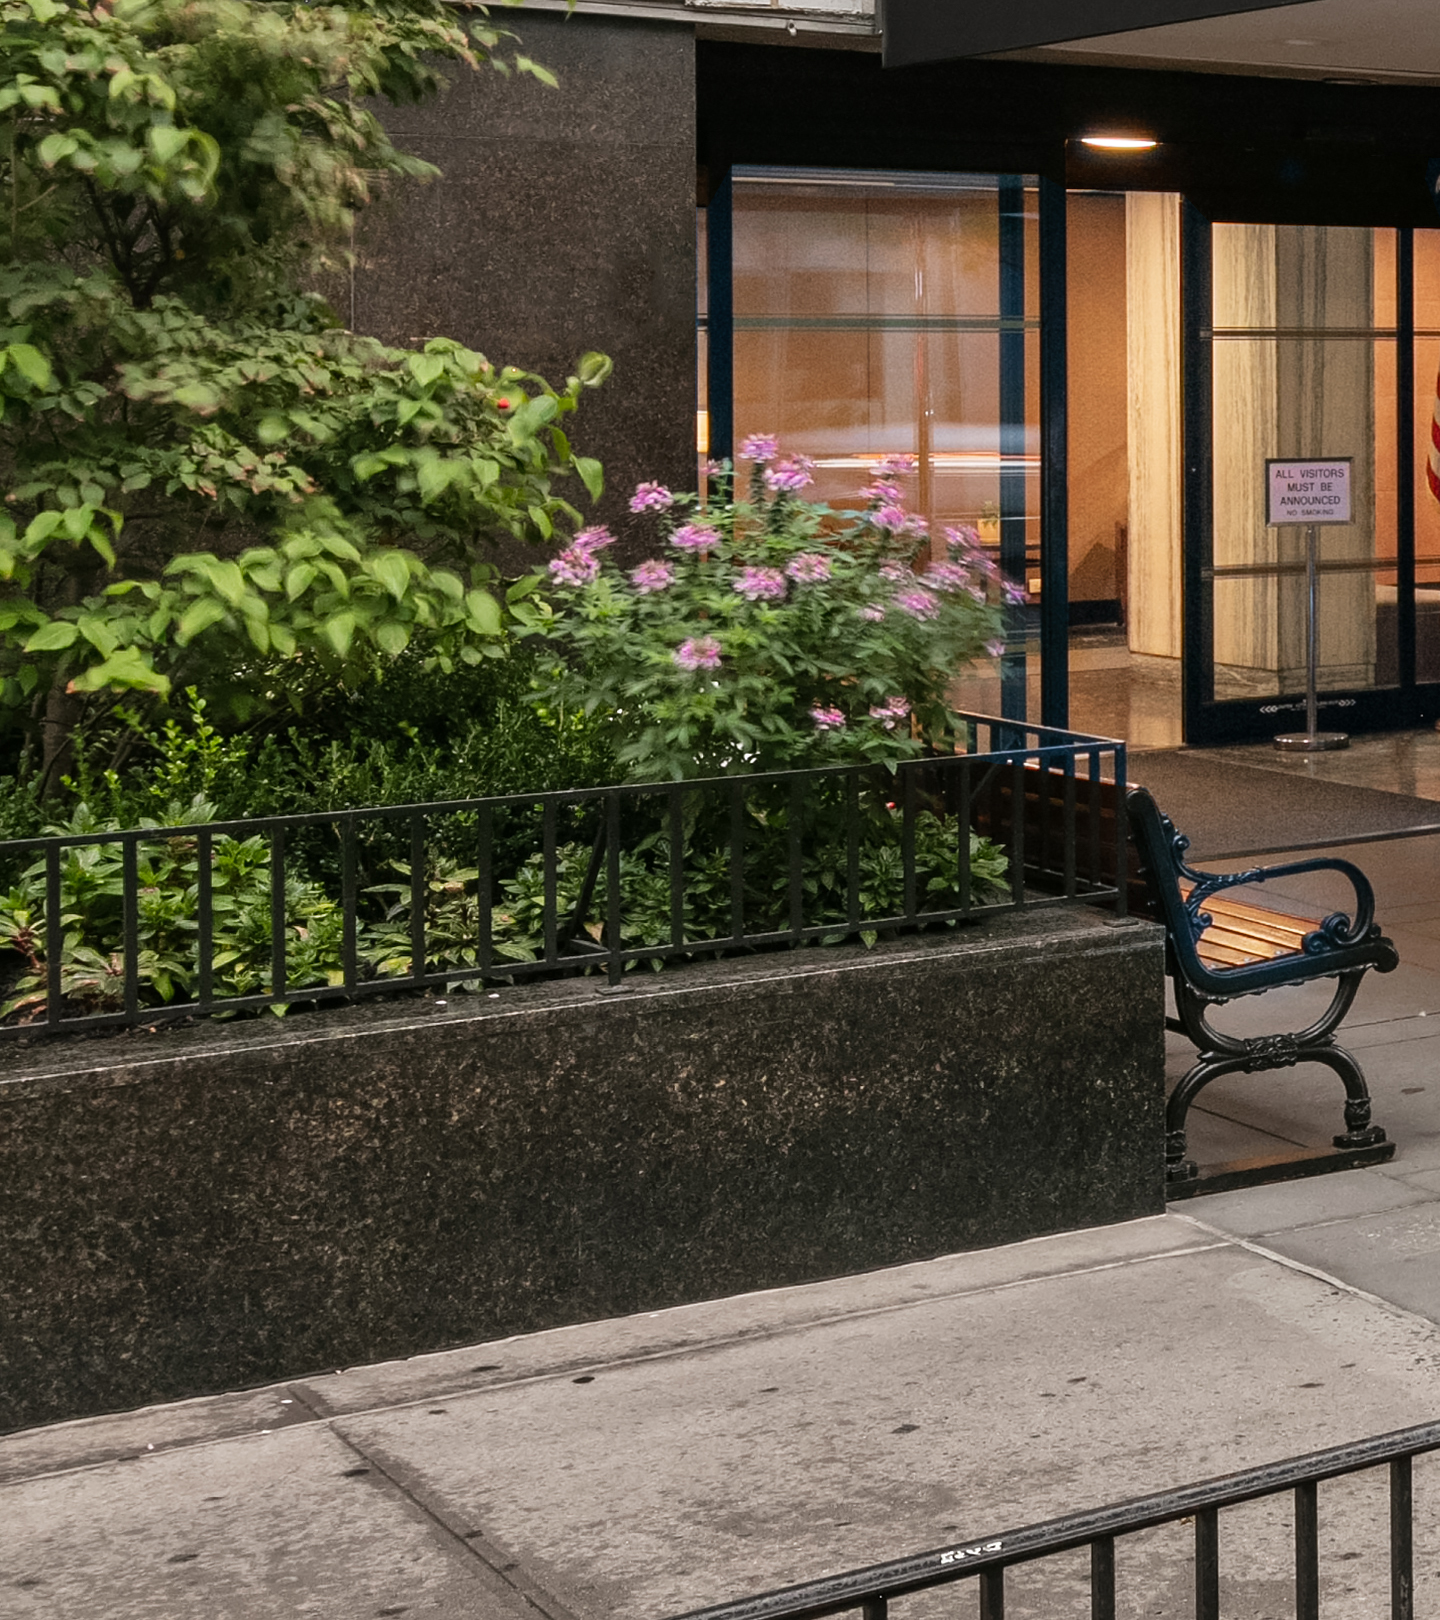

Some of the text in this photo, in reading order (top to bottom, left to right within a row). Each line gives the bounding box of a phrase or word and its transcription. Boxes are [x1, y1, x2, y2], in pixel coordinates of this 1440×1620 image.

[1275, 468, 1345, 479] ALL VISITORS
[1287, 482, 1334, 492] MUST BE
[1280, 495, 1341, 506] ANNOUNCED
